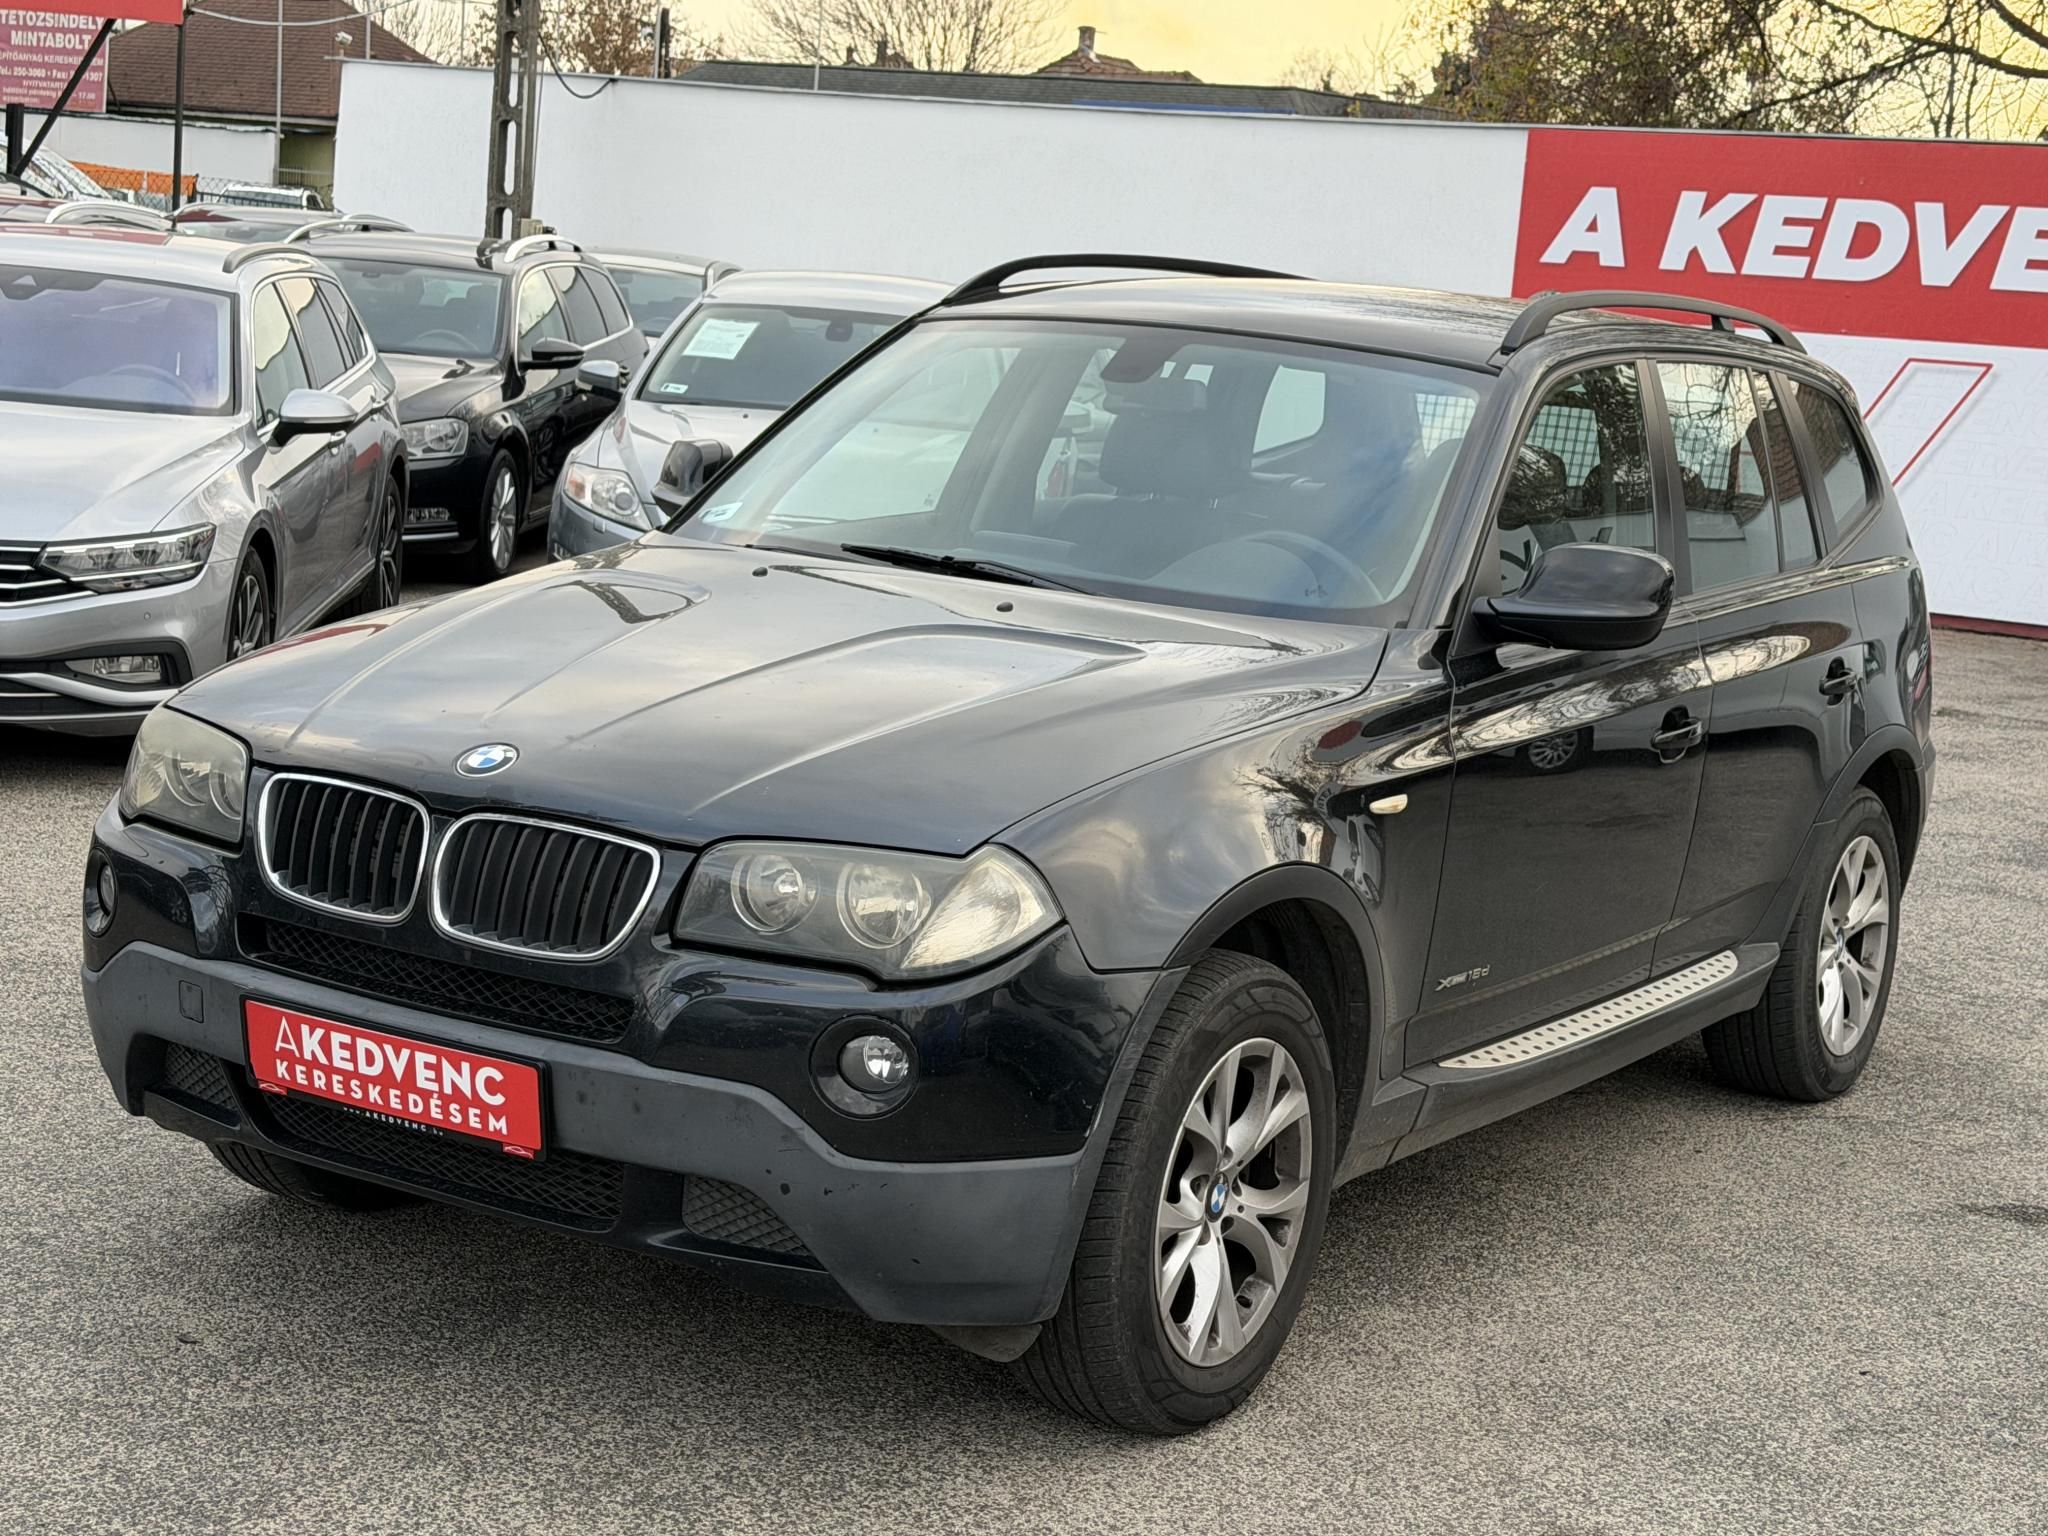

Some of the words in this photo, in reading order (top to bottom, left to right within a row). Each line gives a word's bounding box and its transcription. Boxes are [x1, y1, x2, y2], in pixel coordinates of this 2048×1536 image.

[11, 30, 92, 50] MINTABOLT
[1539, 186, 1626, 268] A
[1658, 190, 2048, 293] KEDVE
[275, 1059, 508, 1136] KERESKEDÉSEM
